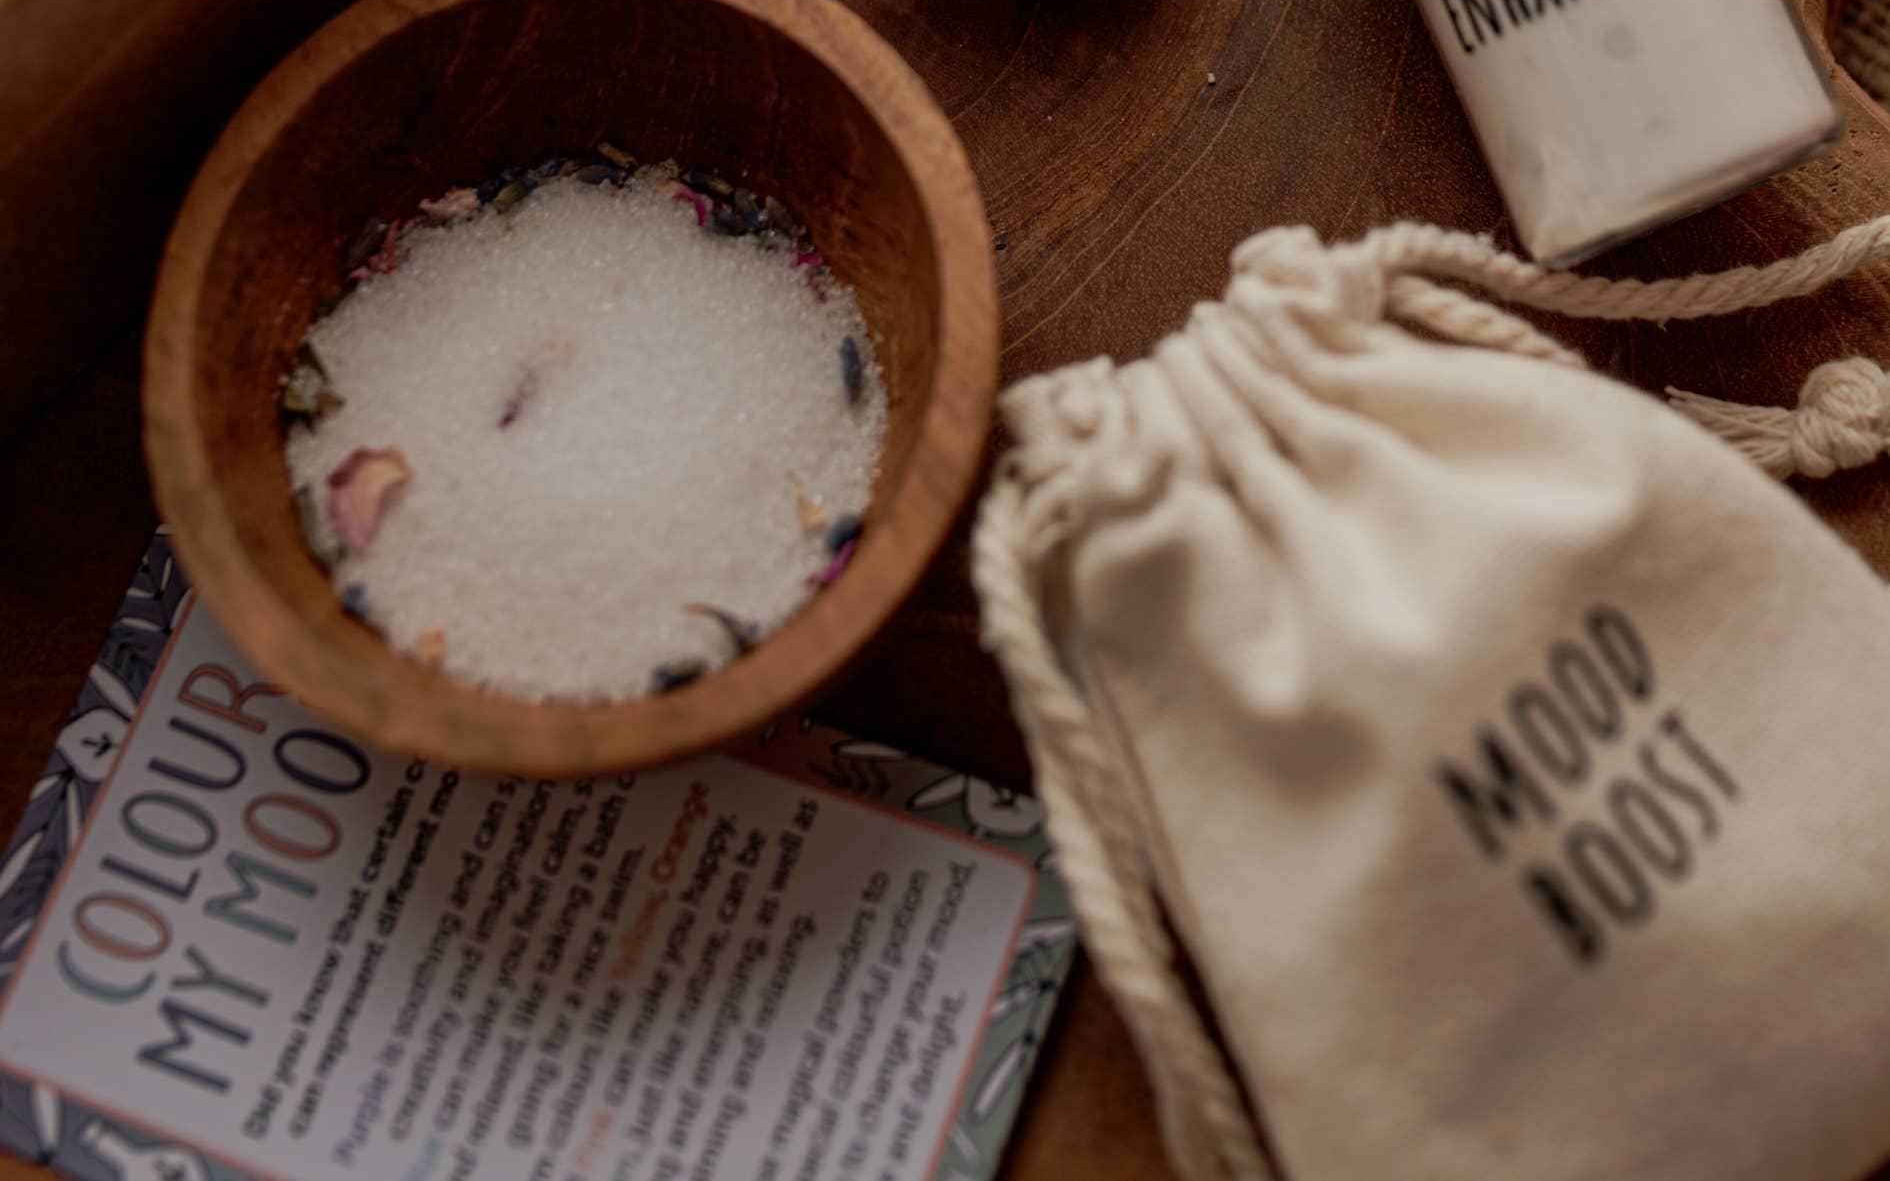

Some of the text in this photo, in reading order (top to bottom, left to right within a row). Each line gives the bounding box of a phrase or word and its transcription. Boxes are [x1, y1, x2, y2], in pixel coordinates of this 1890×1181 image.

[58, 665, 285, 1001] COLOUR
[580, 794, 626, 858] bath
[1433, 602, 1657, 864] MOOD
[274, 1030, 307, 1084] you
[295, 950, 341, 1025] know
[331, 888, 369, 942] that
[361, 787, 413, 882] certain
[290, 1082, 322, 1136] can
[315, 941, 385, 1076] represent
[378, 819, 437, 935] different
[392, 1009, 460, 1139] creativity
[450, 945, 483, 1001] and
[474, 771, 556, 941] imagination
[393, 913, 463, 1036] soothing
[449, 851, 483, 909] and
[472, 800, 507, 851] can
[458, 994, 501, 1071] make
[496, 935, 528, 989] you
[512, 875, 550, 930] feel
[541, 804, 588, 875] calm,
[511, 1062, 557, 1143] going
[540, 1013, 571, 1052] for
[572, 930, 609, 986] nice
[600, 846, 645, 921] swim.
[536, 886, 593, 973] taking
[577, 862, 598, 882] a
[589, 987, 623, 1032] like
[649, 781, 708, 883] Orange
[606, 1053, 635, 1104] can
[628, 969, 670, 1045] make
[662, 909, 695, 965] you
[679, 814, 736, 905] happy.
[651, 1034, 684, 1077] like
[676, 930, 730, 1024] nature,
[717, 871, 748, 923] can
[733, 829, 766, 868] be
[693, 937, 767, 1088] energising,
[754, 897, 779, 928] as
[770, 831, 802, 891] well
[792, 799, 818, 830] as
[816, 909, 875, 1031] powders
[860, 871, 888, 901] to
[881, 870, 927, 967] potion
[901, 954, 935, 1023] your
[926, 861, 975, 949] mood,
[137, 947, 267, 1092] MY
[515, 978, 548, 1024] like
[731, 1032, 763, 1090] and
[755, 914, 815, 1028] relaxing.
